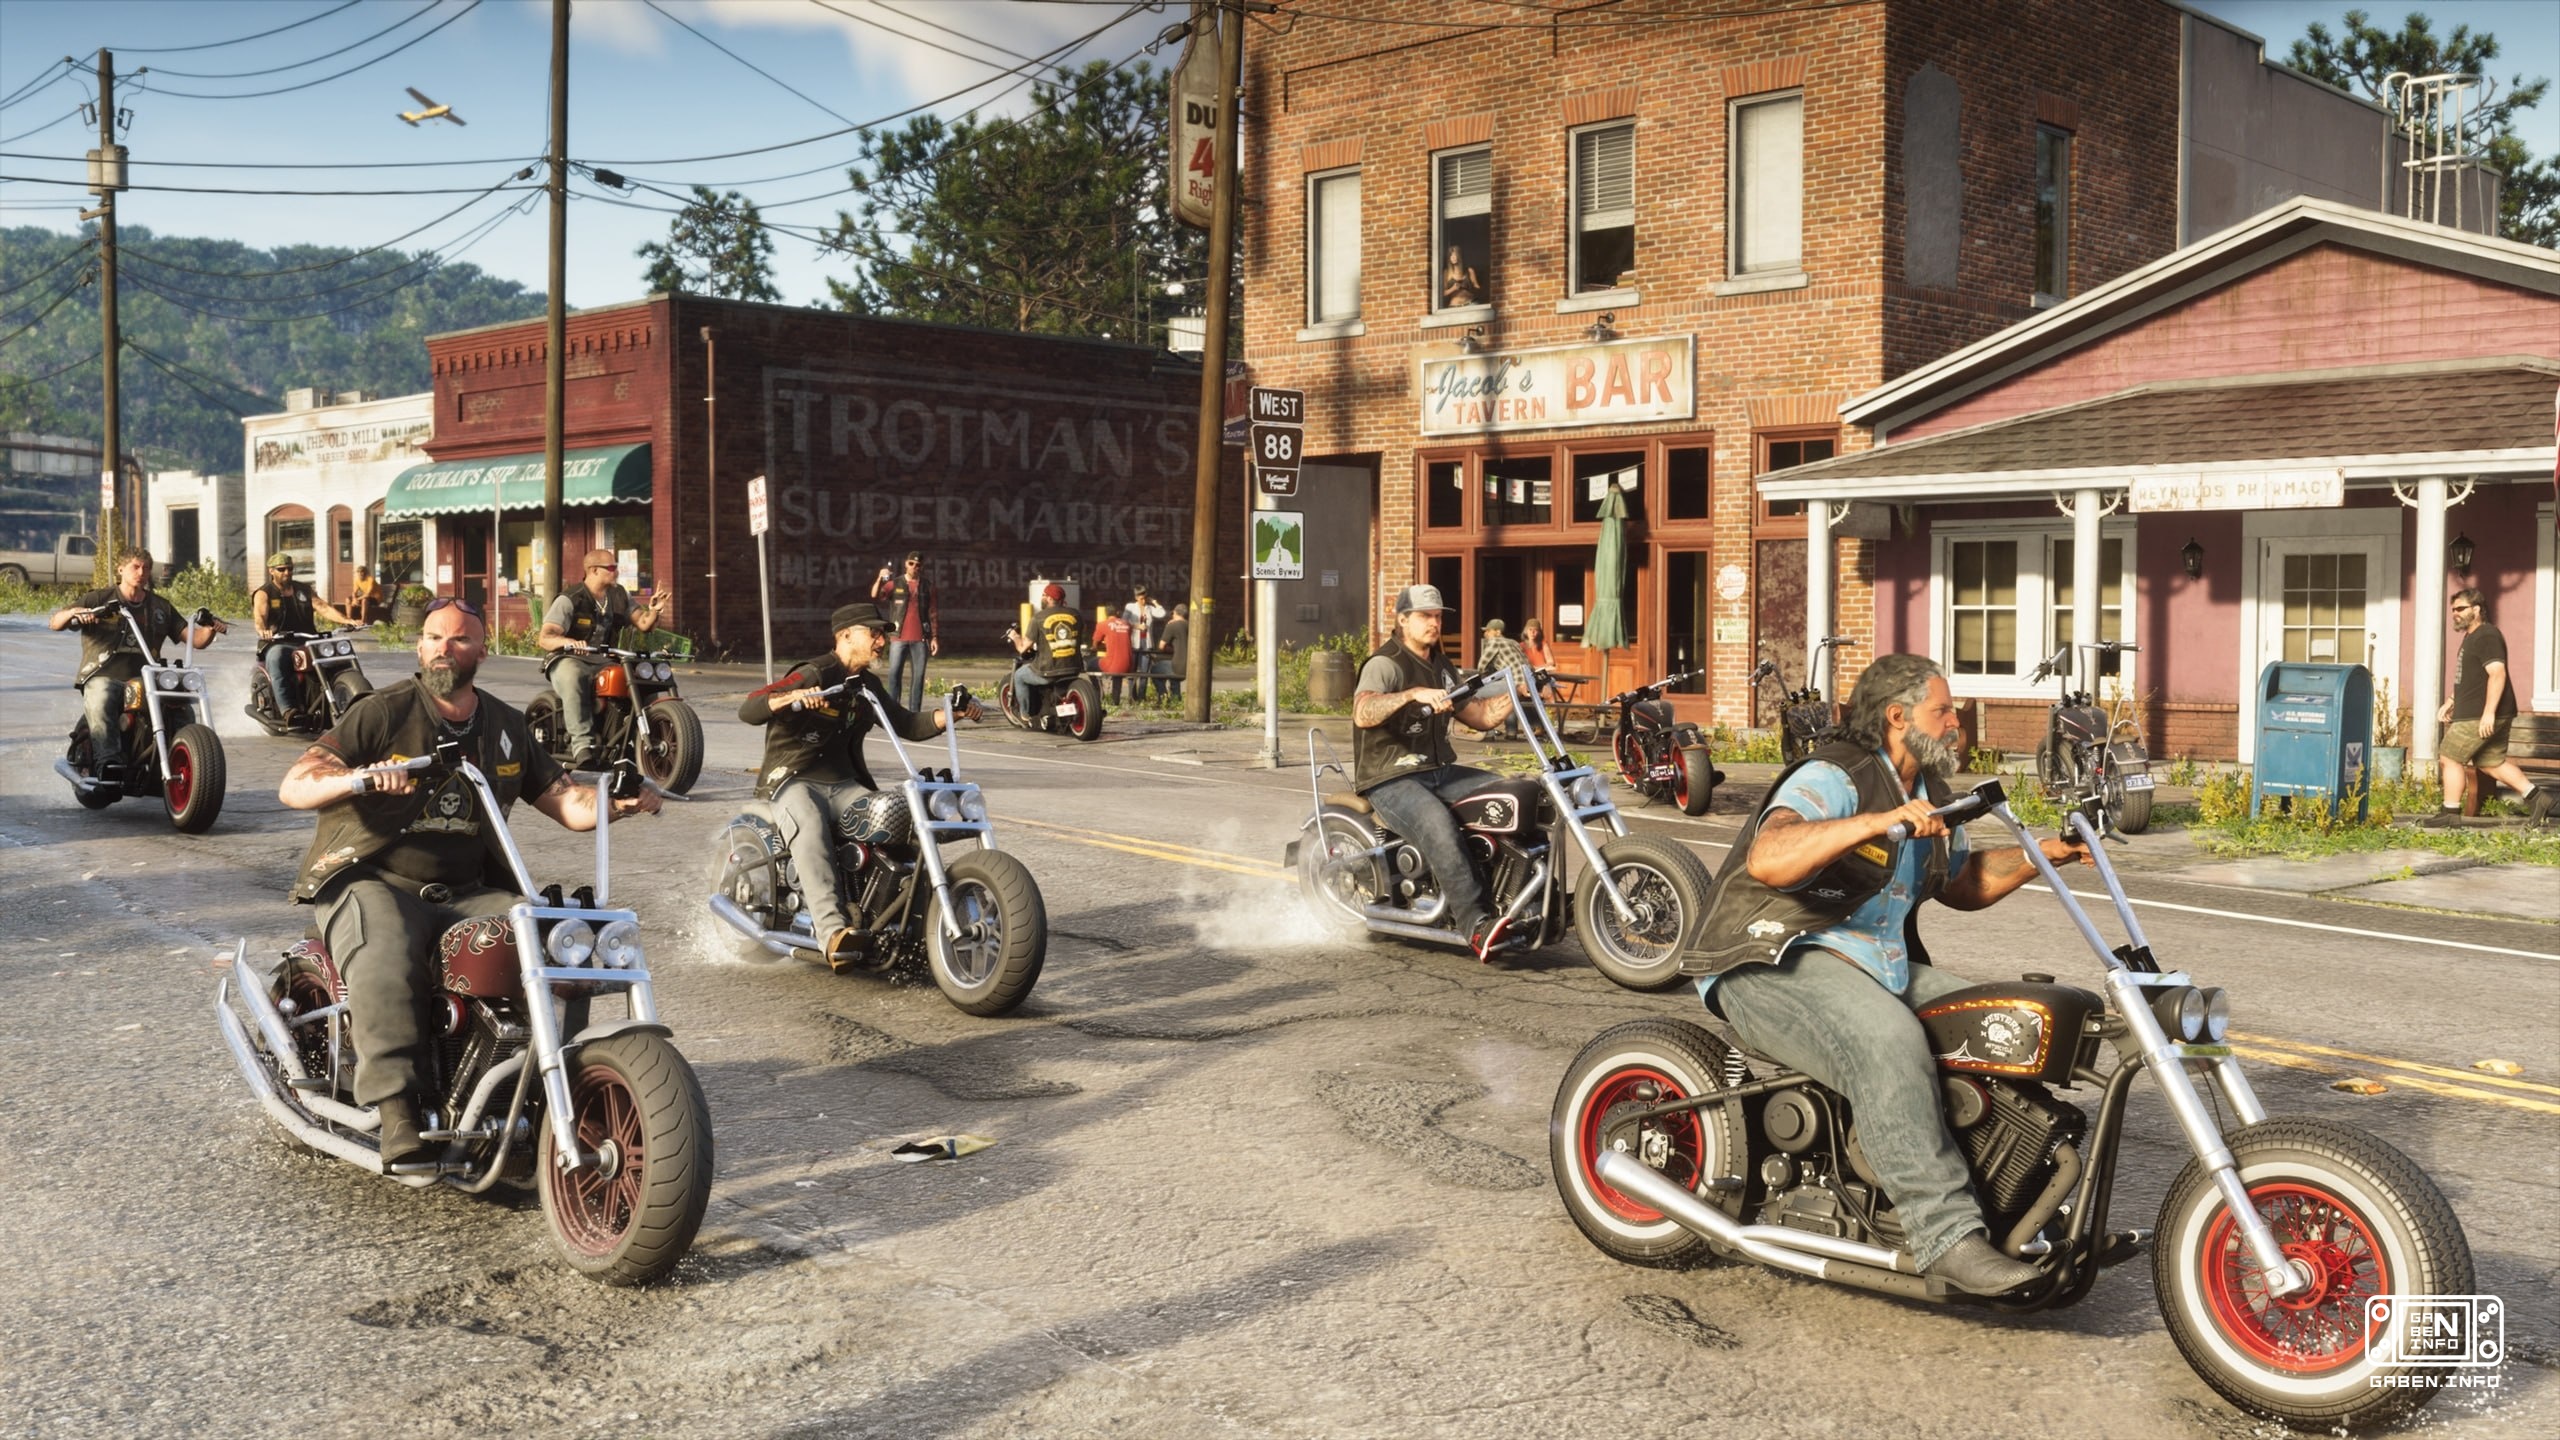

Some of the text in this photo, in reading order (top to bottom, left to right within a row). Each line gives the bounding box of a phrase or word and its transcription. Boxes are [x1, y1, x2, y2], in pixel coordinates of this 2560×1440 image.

[1186, 101, 1217, 129] DU
[1435, 354, 1534, 414] Jacob's
[1565, 349, 1675, 411] BAR
[1259, 391, 1298, 417] WEST
[1452, 395, 1547, 425] TAVERN
[327, 431, 349, 449] OLD
[351, 428, 380, 447] MILL
[776, 388, 1191, 477] TROTMAN'S
[1264, 433, 1293, 460] 88
[348, 448, 369, 461] SHOP
[2236, 480, 2333, 497] PHRMACY
[778, 486, 971, 542] SUPER
[987, 497, 1191, 549] MARKET
[777, 554, 860, 588] MEAT
[1064, 560, 1191, 593] GROCERIES
[1256, 567, 1300, 578] Scenic Byway
